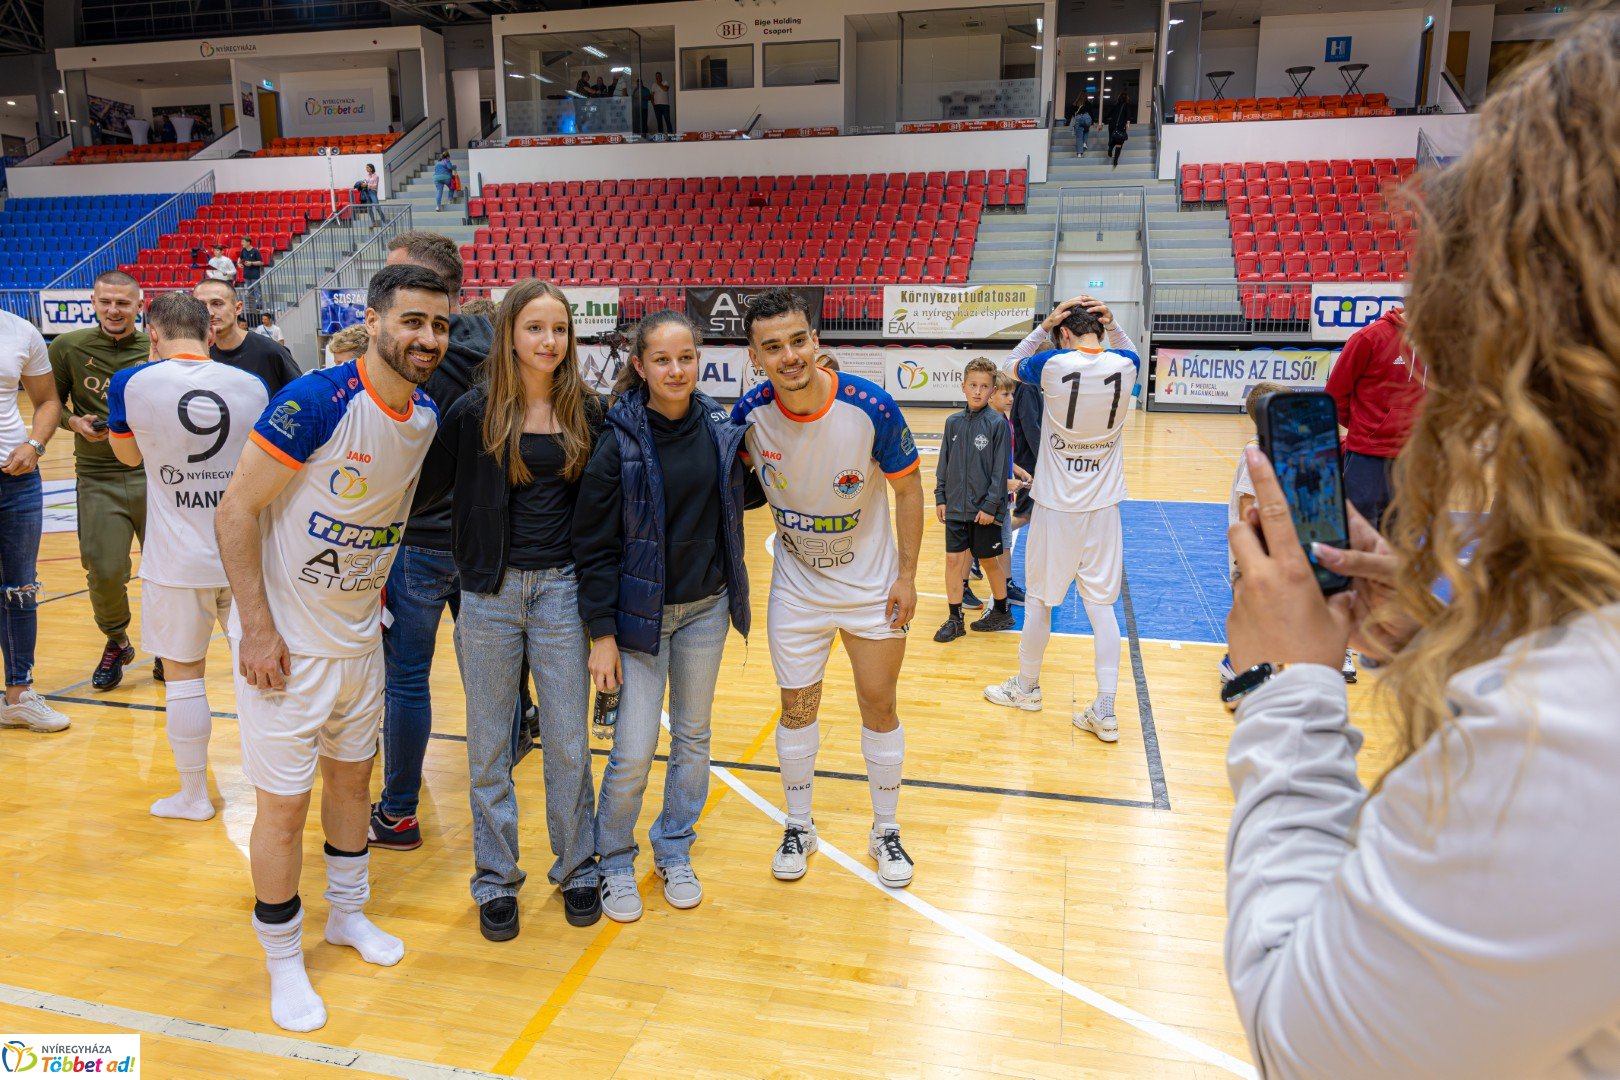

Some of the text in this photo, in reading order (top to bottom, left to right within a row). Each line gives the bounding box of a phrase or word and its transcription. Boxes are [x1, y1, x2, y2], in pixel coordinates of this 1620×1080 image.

[755, 17, 802, 27] Bige Holding
[722, 24, 742, 36] BH
[216, 43, 257, 52] NYÍREGYHÁZA
[323, 104, 352, 116] Többet
[901, 289, 1026, 305] Környezettudatosan
[922, 305, 979, 321] nyíregyházi
[1168, 361, 1178, 377] A
[1182, 355, 1244, 379] PÁCIENS
[1248, 359, 1269, 379] AZ
[1061, 371, 1122, 430] 11
[177, 389, 231, 463] 9
[346, 451, 372, 464] JAKO
[761, 449, 782, 461] JAKO
[1065, 455, 1101, 473] TÓTH
[298, 566, 387, 592] STUDIO
[786, 783, 812, 791] JAKO
